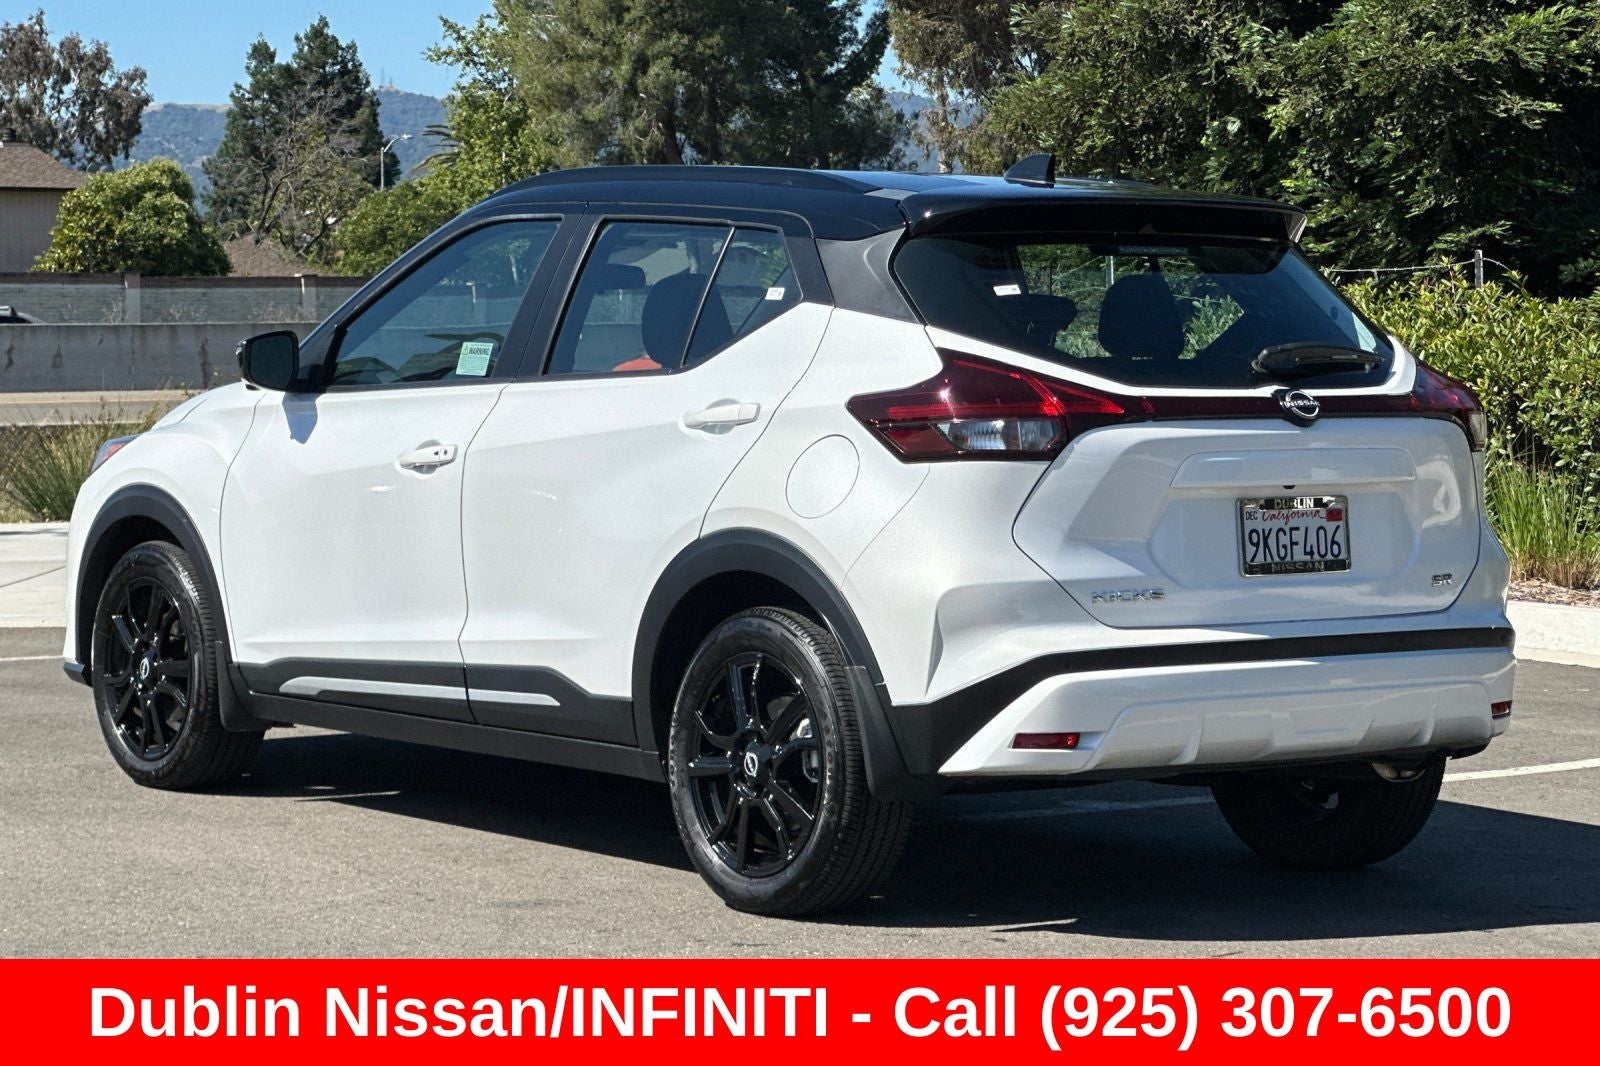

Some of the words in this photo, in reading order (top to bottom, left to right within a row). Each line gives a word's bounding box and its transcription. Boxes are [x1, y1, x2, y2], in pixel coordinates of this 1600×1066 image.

[469, 347, 490, 356] WARNING
[1282, 400, 1320, 408] NISSAN
[1245, 511, 1258, 521] DEC
[1262, 509, 1320, 525] California
[1248, 524, 1342, 563] 9KGF406
[1271, 561, 1325, 573] NISSAN
[1431, 573, 1453, 587] SR
[1092, 589, 1165, 603] KICKS
